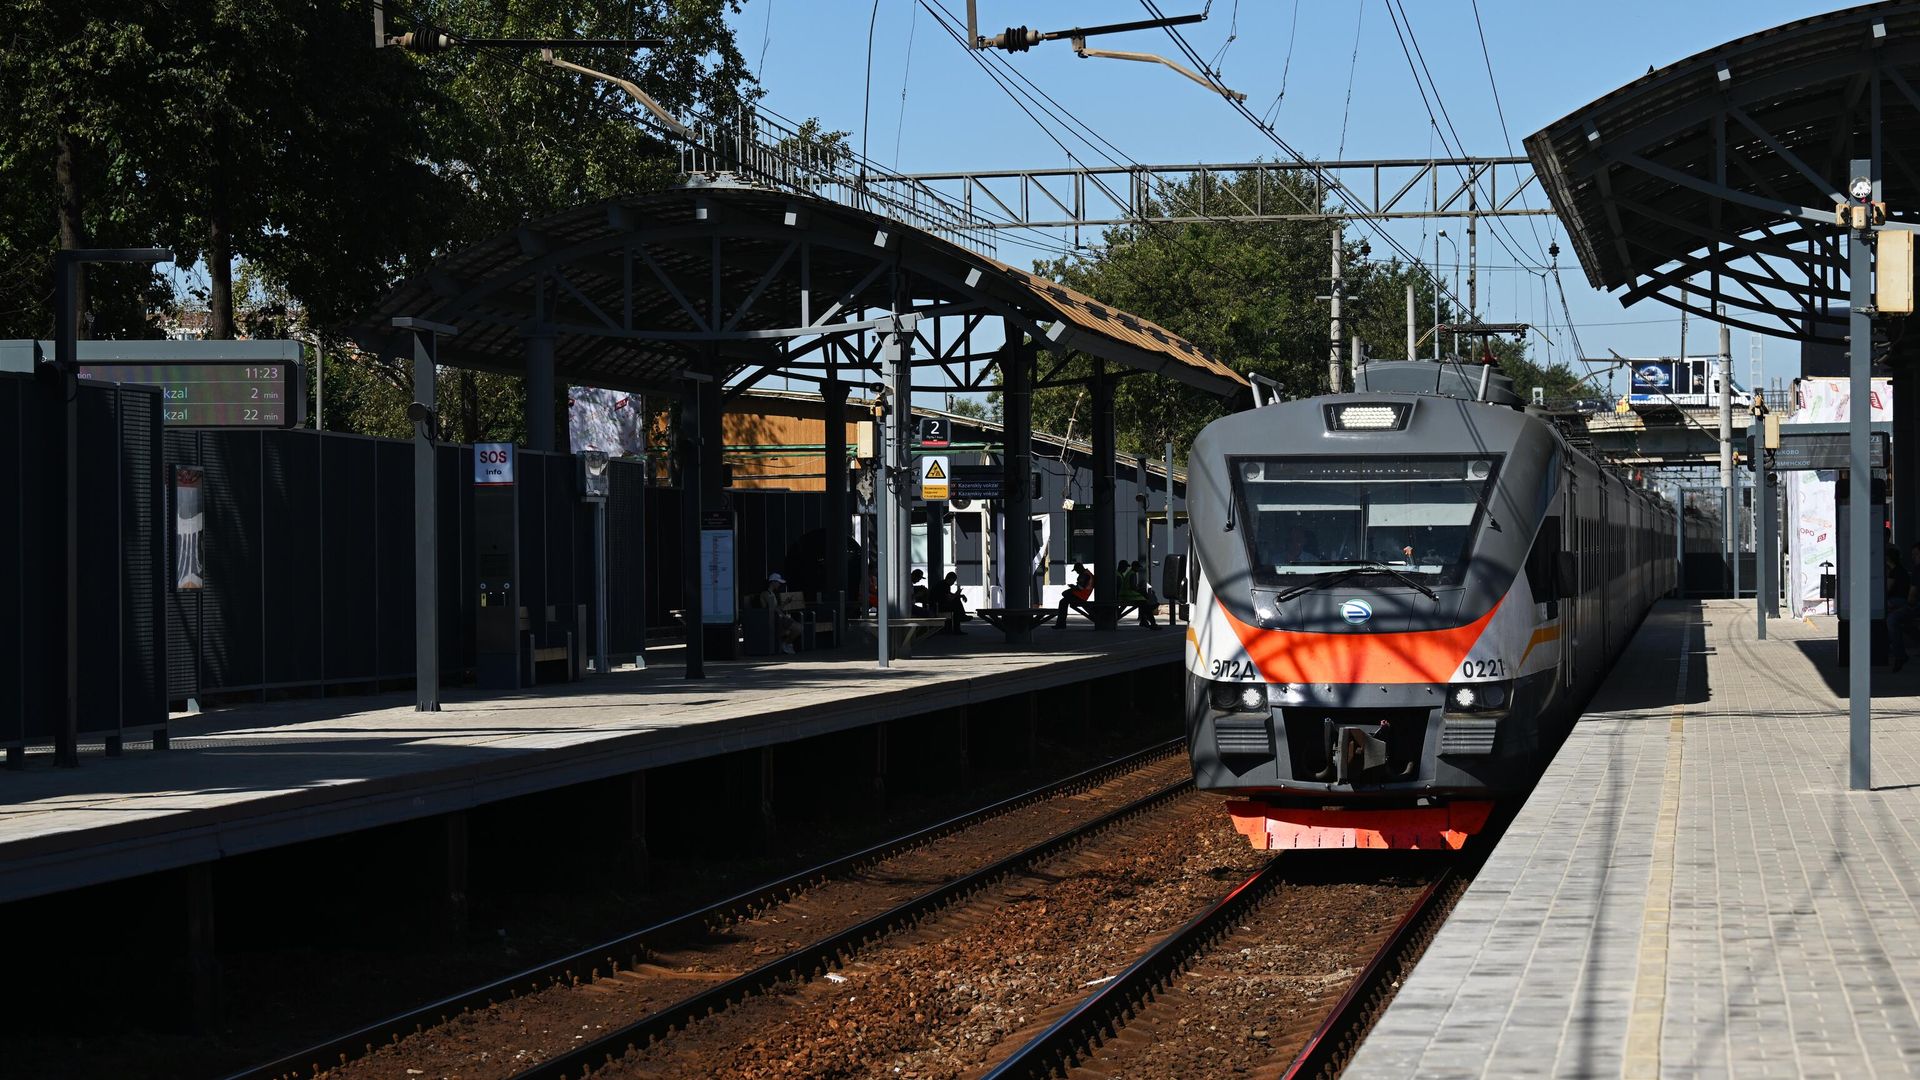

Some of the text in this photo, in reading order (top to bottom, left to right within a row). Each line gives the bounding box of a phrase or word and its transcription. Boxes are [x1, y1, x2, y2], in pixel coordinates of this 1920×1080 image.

[245, 367, 278, 379] 11:23
[163, 387, 188, 399] kzal
[251, 388, 259, 399] 2
[163, 408, 188, 420] kzal
[243, 409, 279, 420] 22 min
[930, 421, 940, 434] 2
[480, 450, 507, 464] SOS
[486, 468, 503, 476] info
[1210, 658, 1257, 681] ЭП2Д
[1462, 658, 1505, 679] 0221
